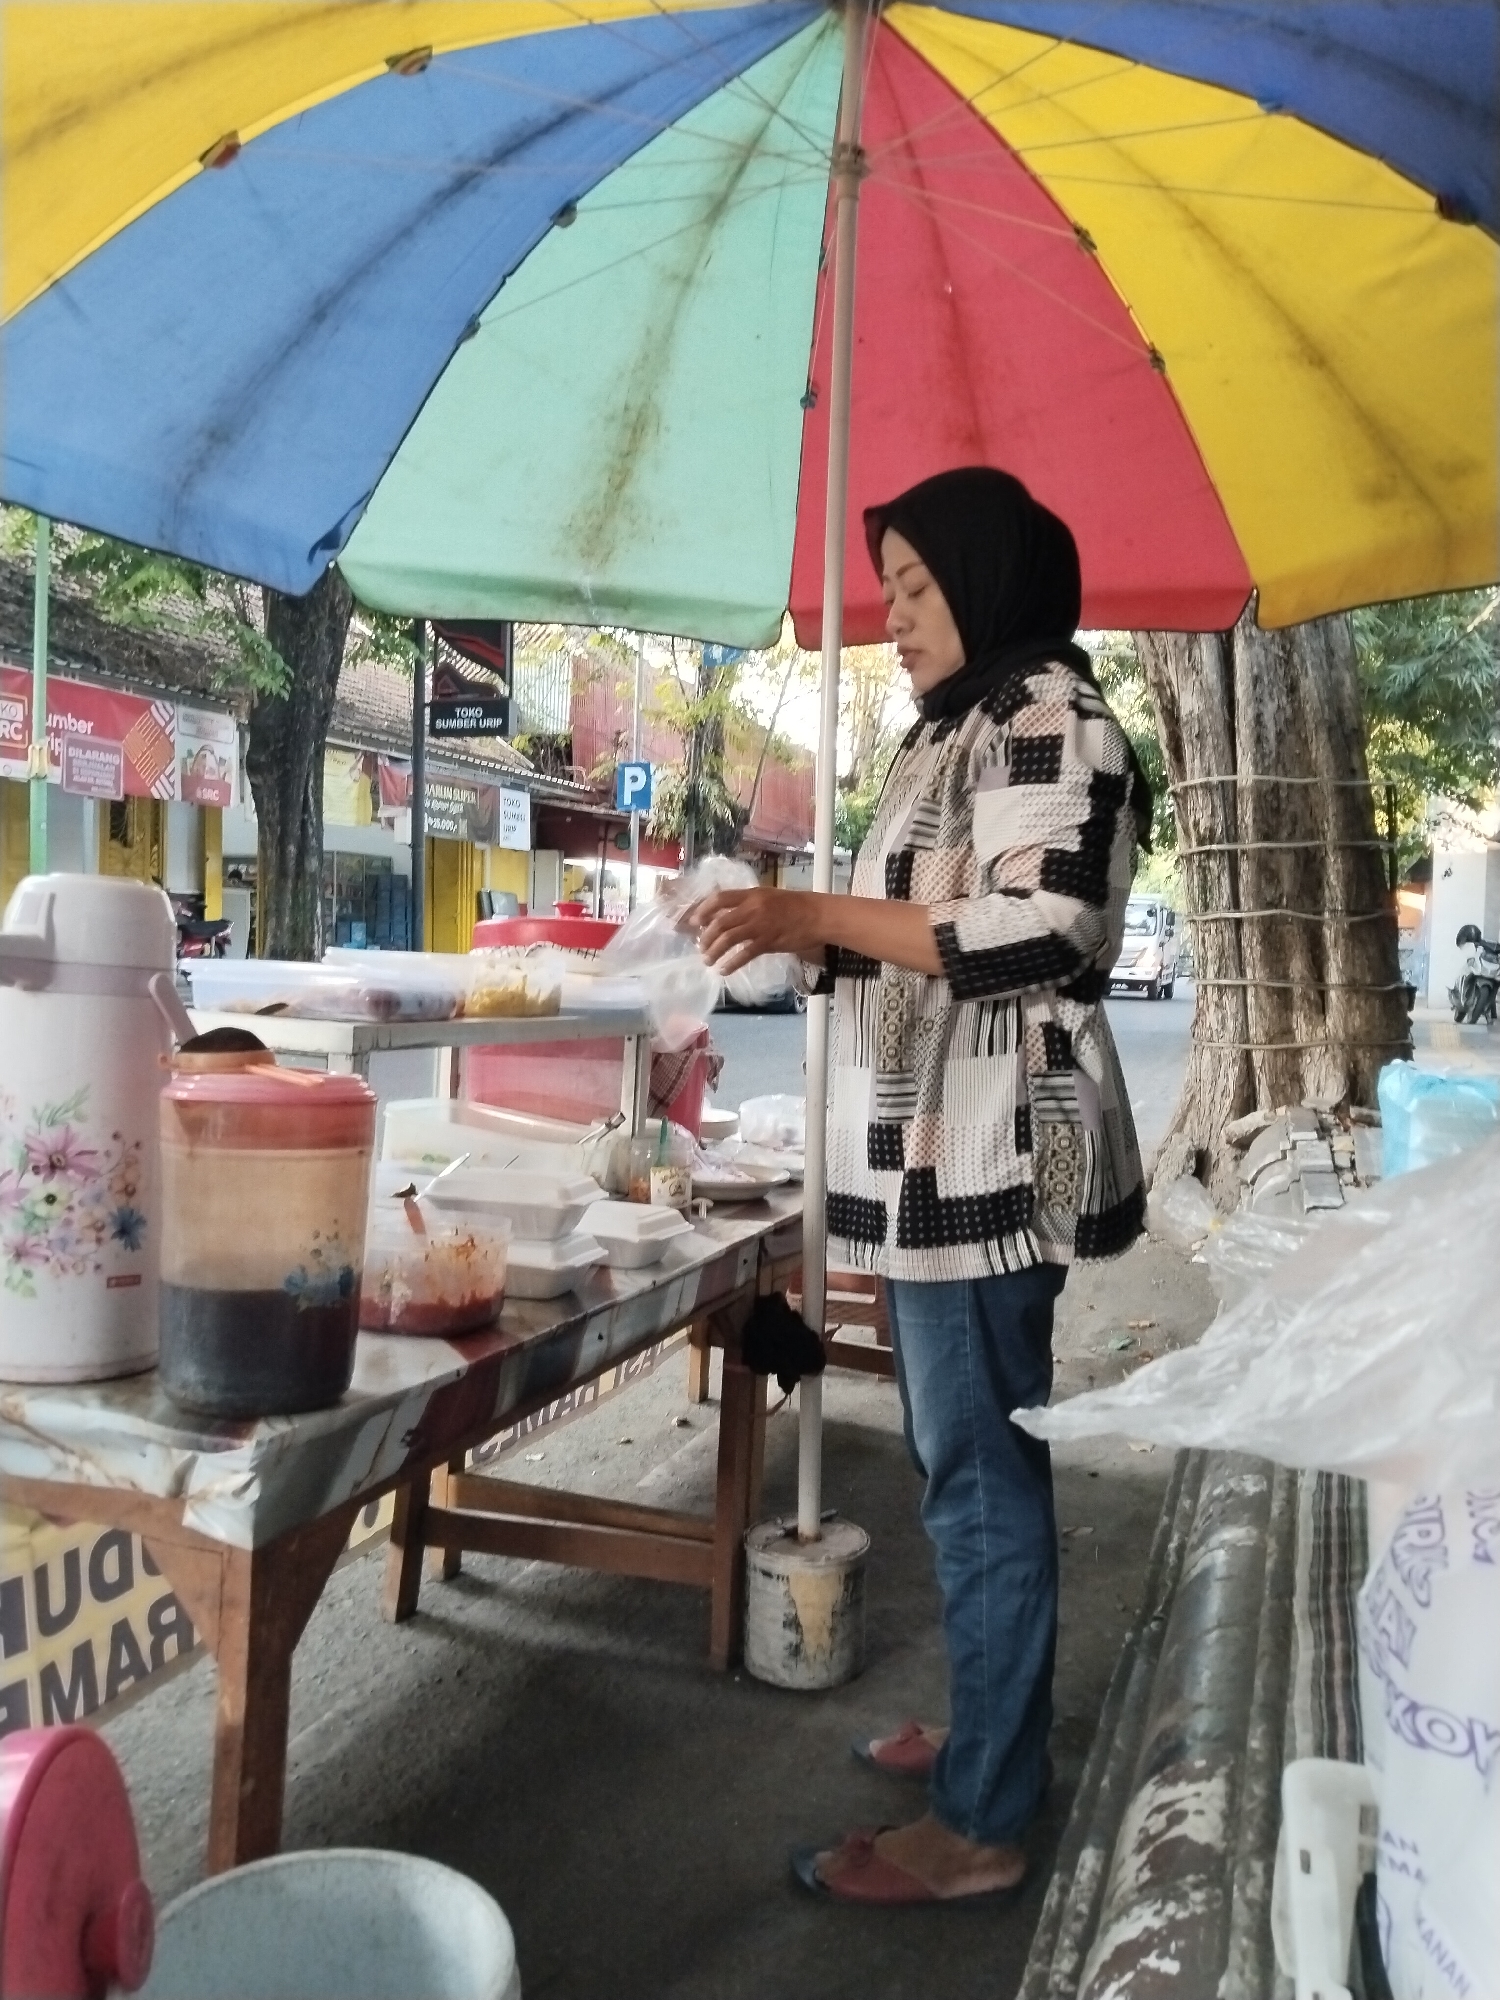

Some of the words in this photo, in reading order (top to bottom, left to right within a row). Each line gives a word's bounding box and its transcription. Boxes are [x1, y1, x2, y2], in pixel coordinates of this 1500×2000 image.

[455, 706, 483, 718] TOKO
[44, 712, 94, 735] umber
[435, 718, 476, 730] SUMBER
[479, 717, 503, 729] URIP
[67, 746, 120, 766] DILARANG
[624, 766, 647, 806] P
